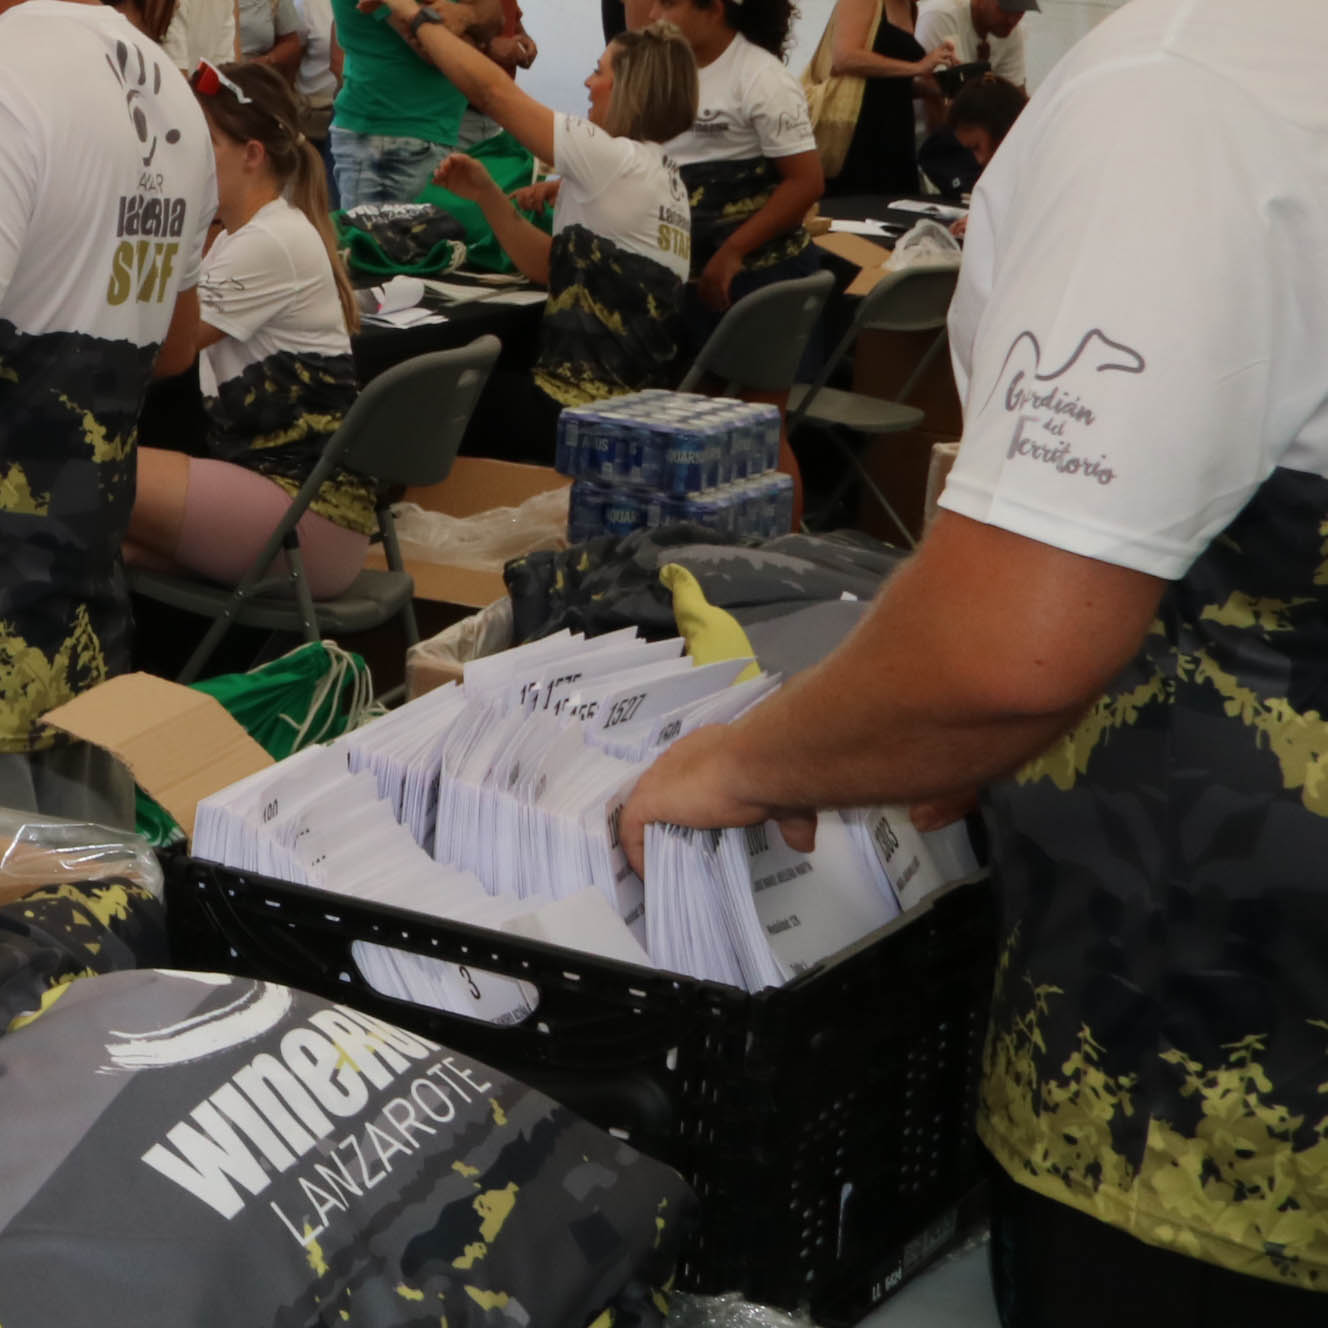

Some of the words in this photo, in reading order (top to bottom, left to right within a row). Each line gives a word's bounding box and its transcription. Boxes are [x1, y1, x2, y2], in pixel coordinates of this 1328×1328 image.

[1006, 414, 1118, 486] Territorio
[602, 693, 648, 730] 1527
[459, 965, 482, 1001] 3
[270, 1057, 492, 1248] LANZAROTE
